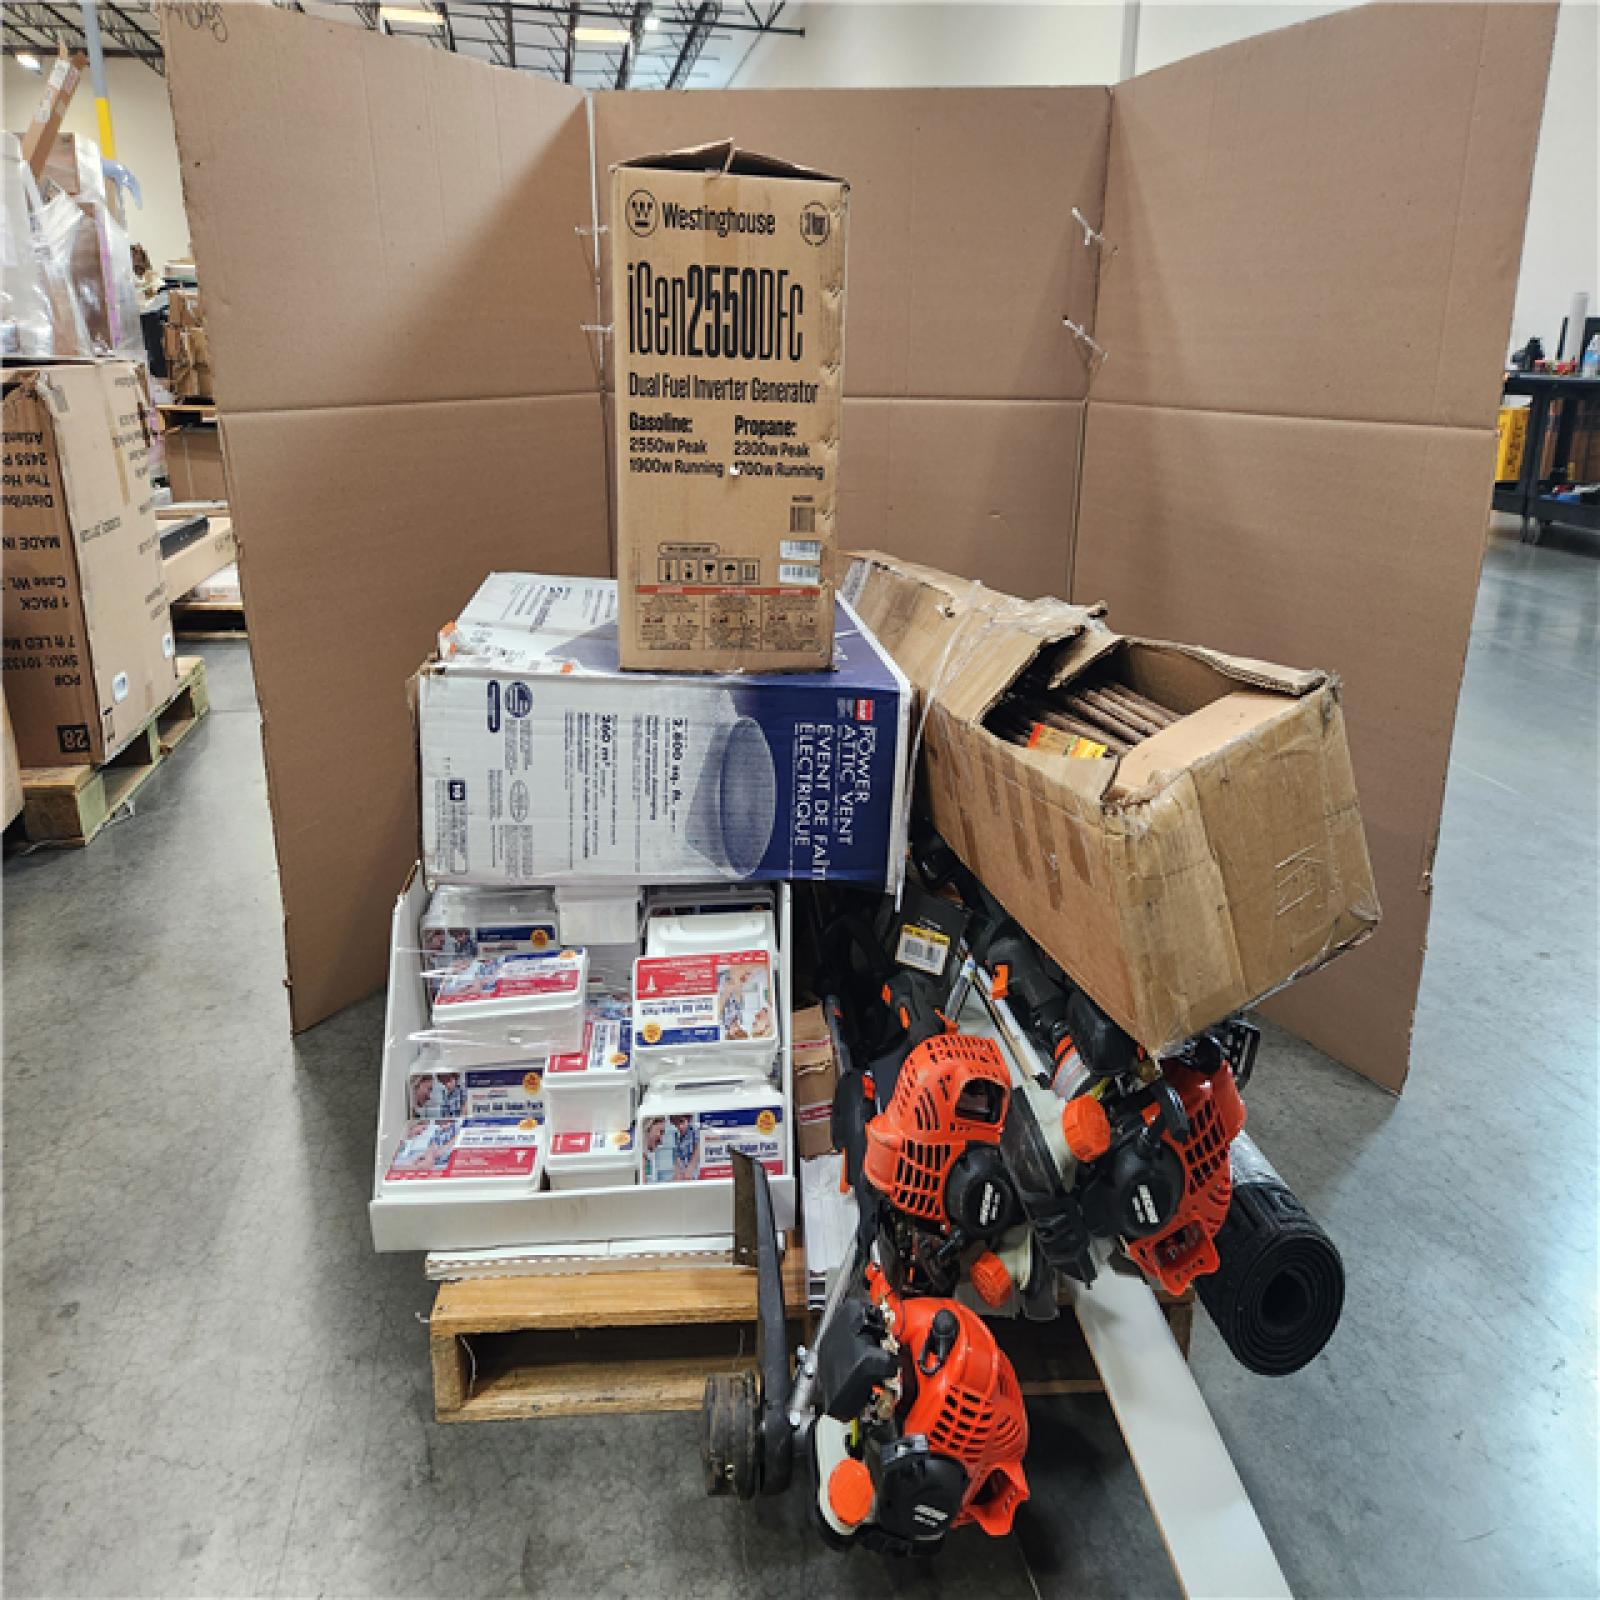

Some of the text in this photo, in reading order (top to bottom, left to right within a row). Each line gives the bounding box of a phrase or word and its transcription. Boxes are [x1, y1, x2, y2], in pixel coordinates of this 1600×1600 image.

[662, 202, 776, 237] Westinghouse
[627, 261, 804, 361] iGen2550DFc
[628, 372, 819, 403] Dual Fuel Inverter Generator
[629, 412, 694, 433] Gasoline:
[734, 415, 798, 439] Propane:
[3, 432, 43, 445] Atlant
[629, 437, 708, 455] 2550w Peak
[734, 440, 810, 458] 2300w Peak
[2, 452, 13, 465] P
[629, 457, 725, 478] 1900w Running
[2, 474, 51, 488] The Ho
[775, 462, 826, 481] Running
[2, 494, 54, 508] Distribu
[20, 536, 61, 549] MADE
[32, 576, 66, 589] Case
[20, 597, 58, 610] PACK
[24, 637, 50, 649] LED
[816, 724, 835, 791] ÉVENT
[839, 724, 857, 783] ATTIC
[855, 725, 875, 804] POWER
[795, 722, 816, 847] ÉLECTRIQUE
[814, 799, 830, 826] DE
[838, 791, 854, 846] VENT
